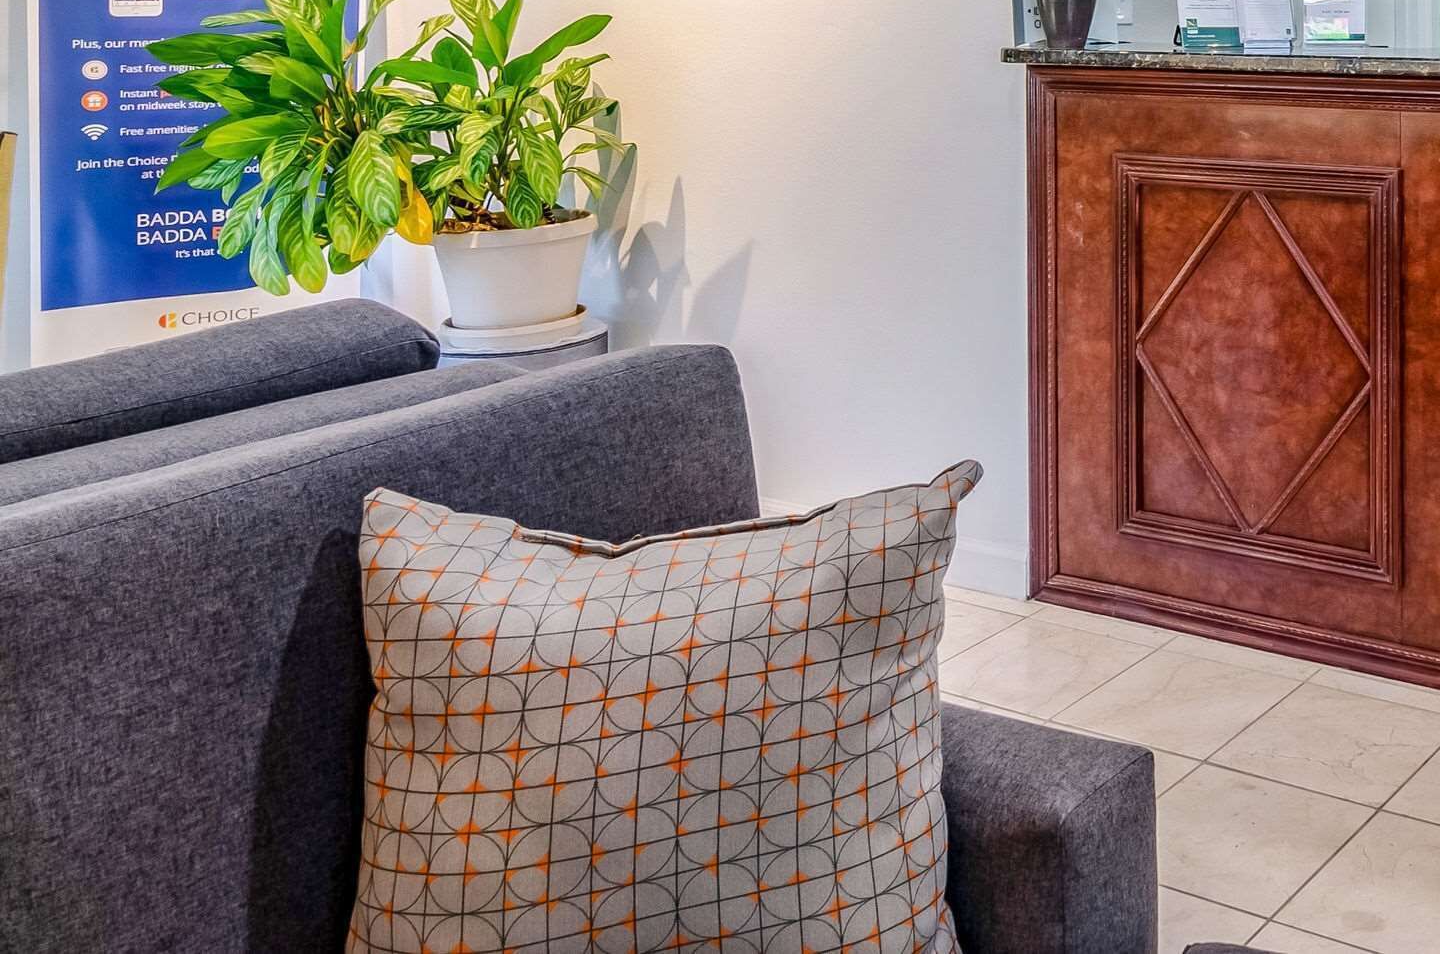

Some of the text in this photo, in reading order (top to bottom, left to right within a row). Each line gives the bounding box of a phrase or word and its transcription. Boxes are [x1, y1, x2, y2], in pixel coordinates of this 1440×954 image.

[72, 39, 101, 50] Plus,
[104, 40, 128, 49] our
[119, 64, 143, 73] Fast
[145, 63, 167, 73] free
[119, 89, 159, 98] Instant
[119, 103, 135, 112] on
[137, 100, 187, 110] midweek
[188, 100, 217, 111] stays
[119, 125, 199, 137] Free amenities
[75, 159, 100, 172] Join
[103, 158, 124, 168] the
[127, 156, 169, 167] Choice
[141, 171, 153, 179] at
[137, 209, 208, 228] BADDA
[137, 227, 208, 246] BADDA
[175, 249, 190, 259] It's
[192, 247, 215, 257] that
[182, 307, 260, 326] CHOICE
